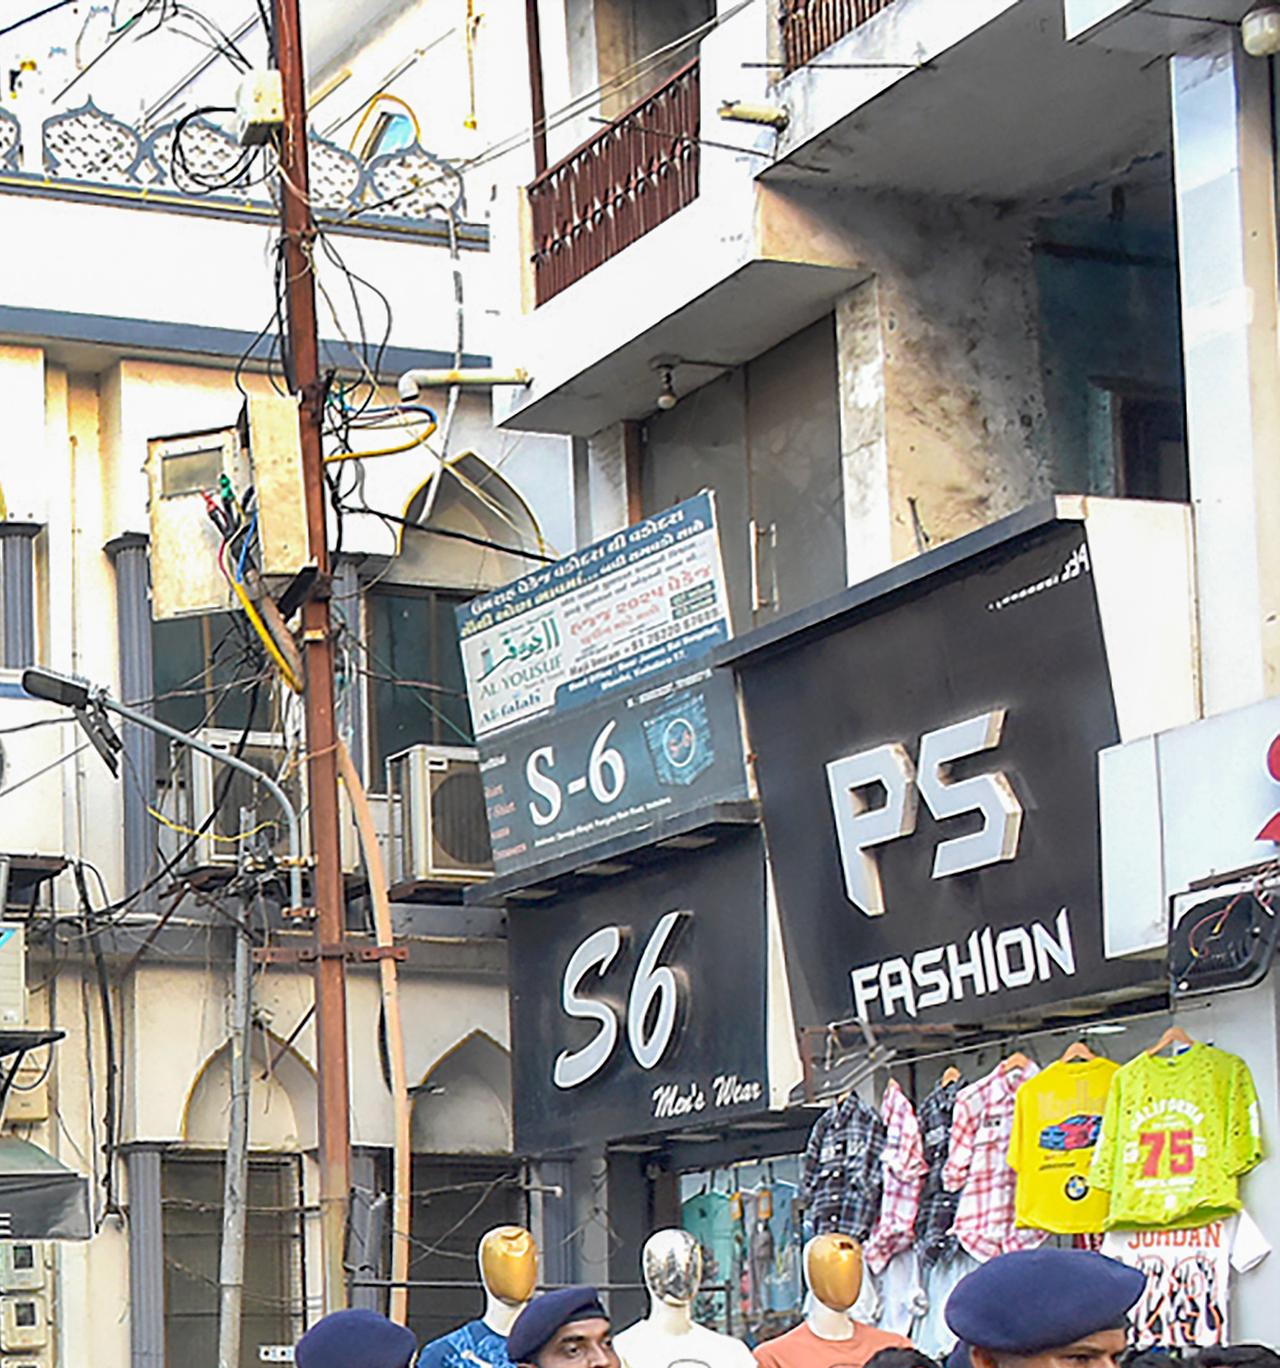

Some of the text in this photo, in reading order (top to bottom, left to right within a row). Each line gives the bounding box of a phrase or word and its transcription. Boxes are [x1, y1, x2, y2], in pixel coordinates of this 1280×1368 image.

[501, 654, 562, 689] YOUSUF
[526, 720, 626, 826] S-6
[826, 709, 1023, 916] PS
[554, 911, 686, 1088] S6
[851, 907, 1077, 1024] FASHION
[652, 1075, 764, 1119] Men's Wear
[1139, 1130, 1195, 1178] 75
